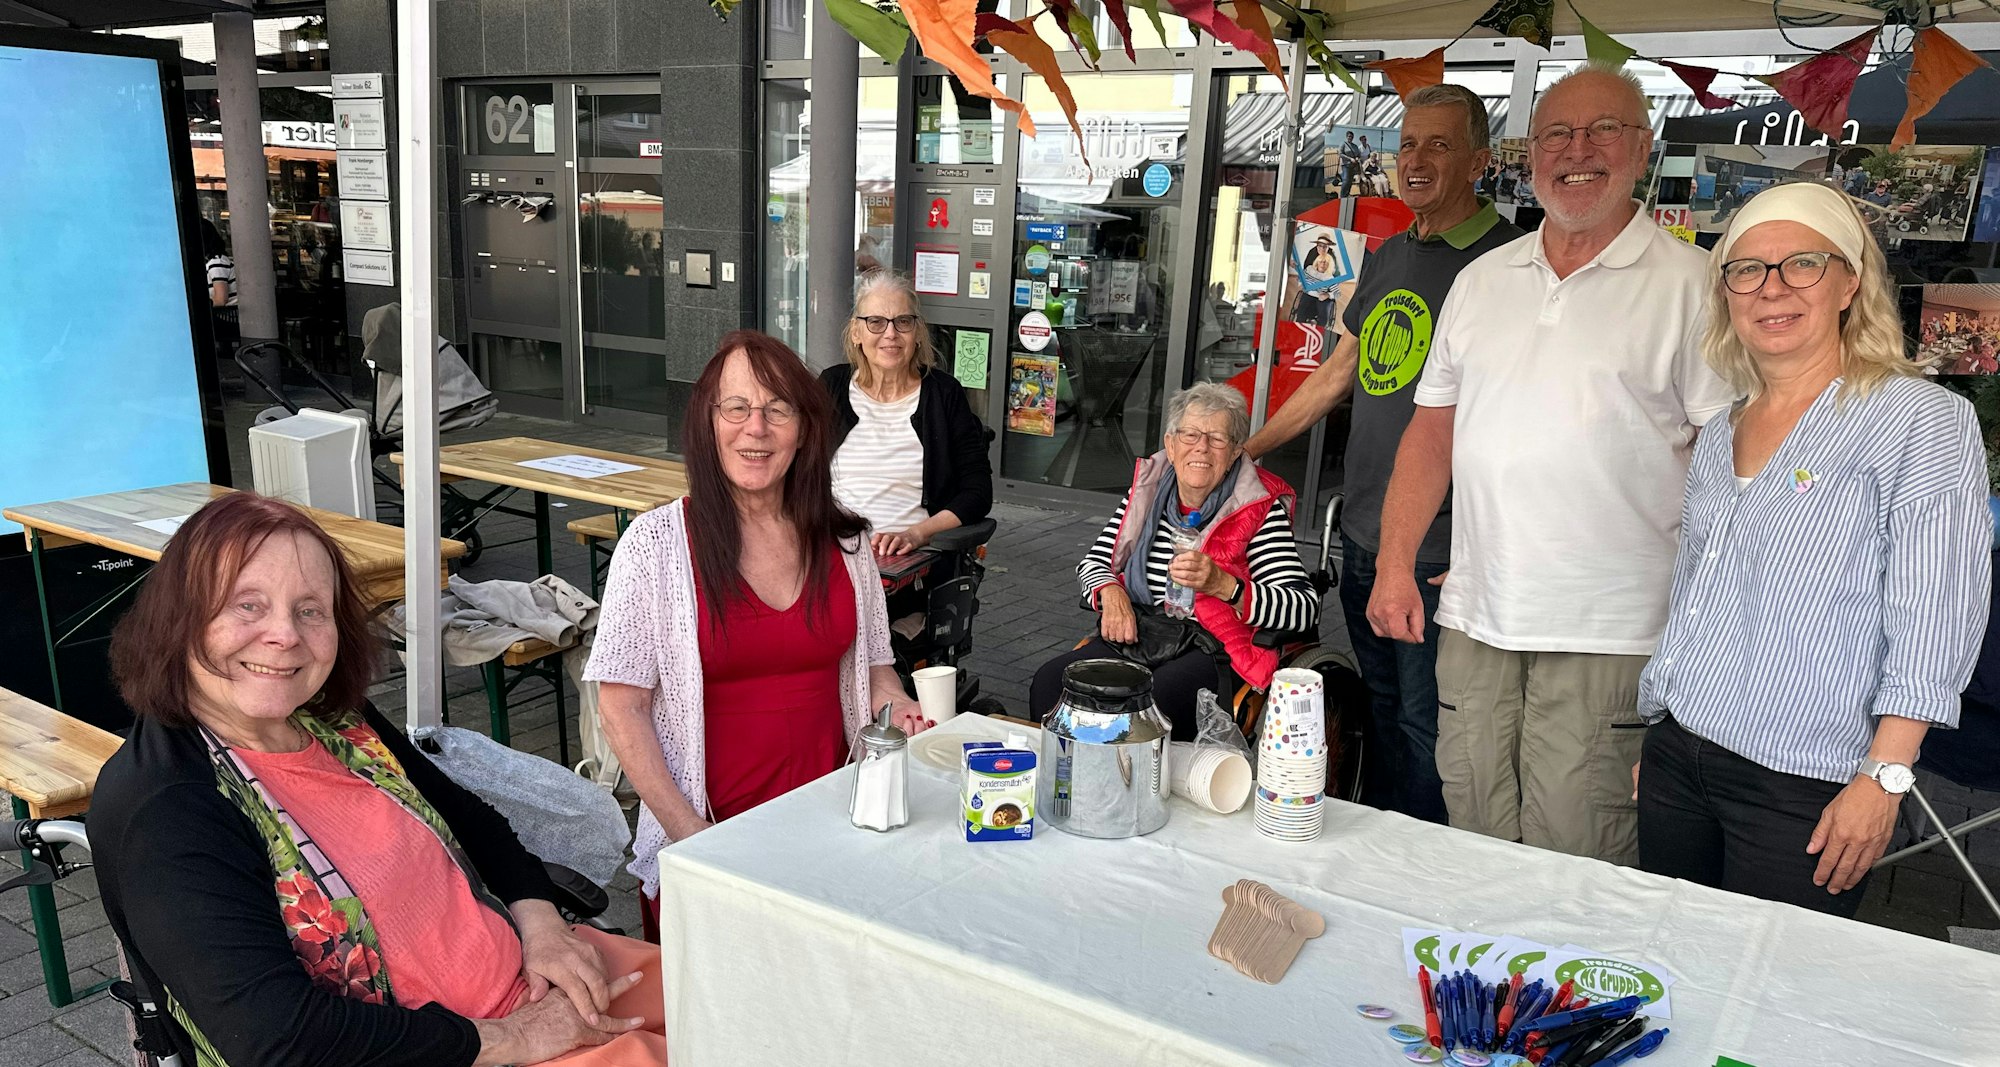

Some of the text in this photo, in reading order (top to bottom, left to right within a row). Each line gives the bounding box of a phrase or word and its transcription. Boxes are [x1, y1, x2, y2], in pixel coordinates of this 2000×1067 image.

[364, 80, 372, 89] 62
[485, 95, 530, 144] 62
[1110, 293, 1132, 305] ,95€
[1579, 959, 1645, 975] Troisdorf
